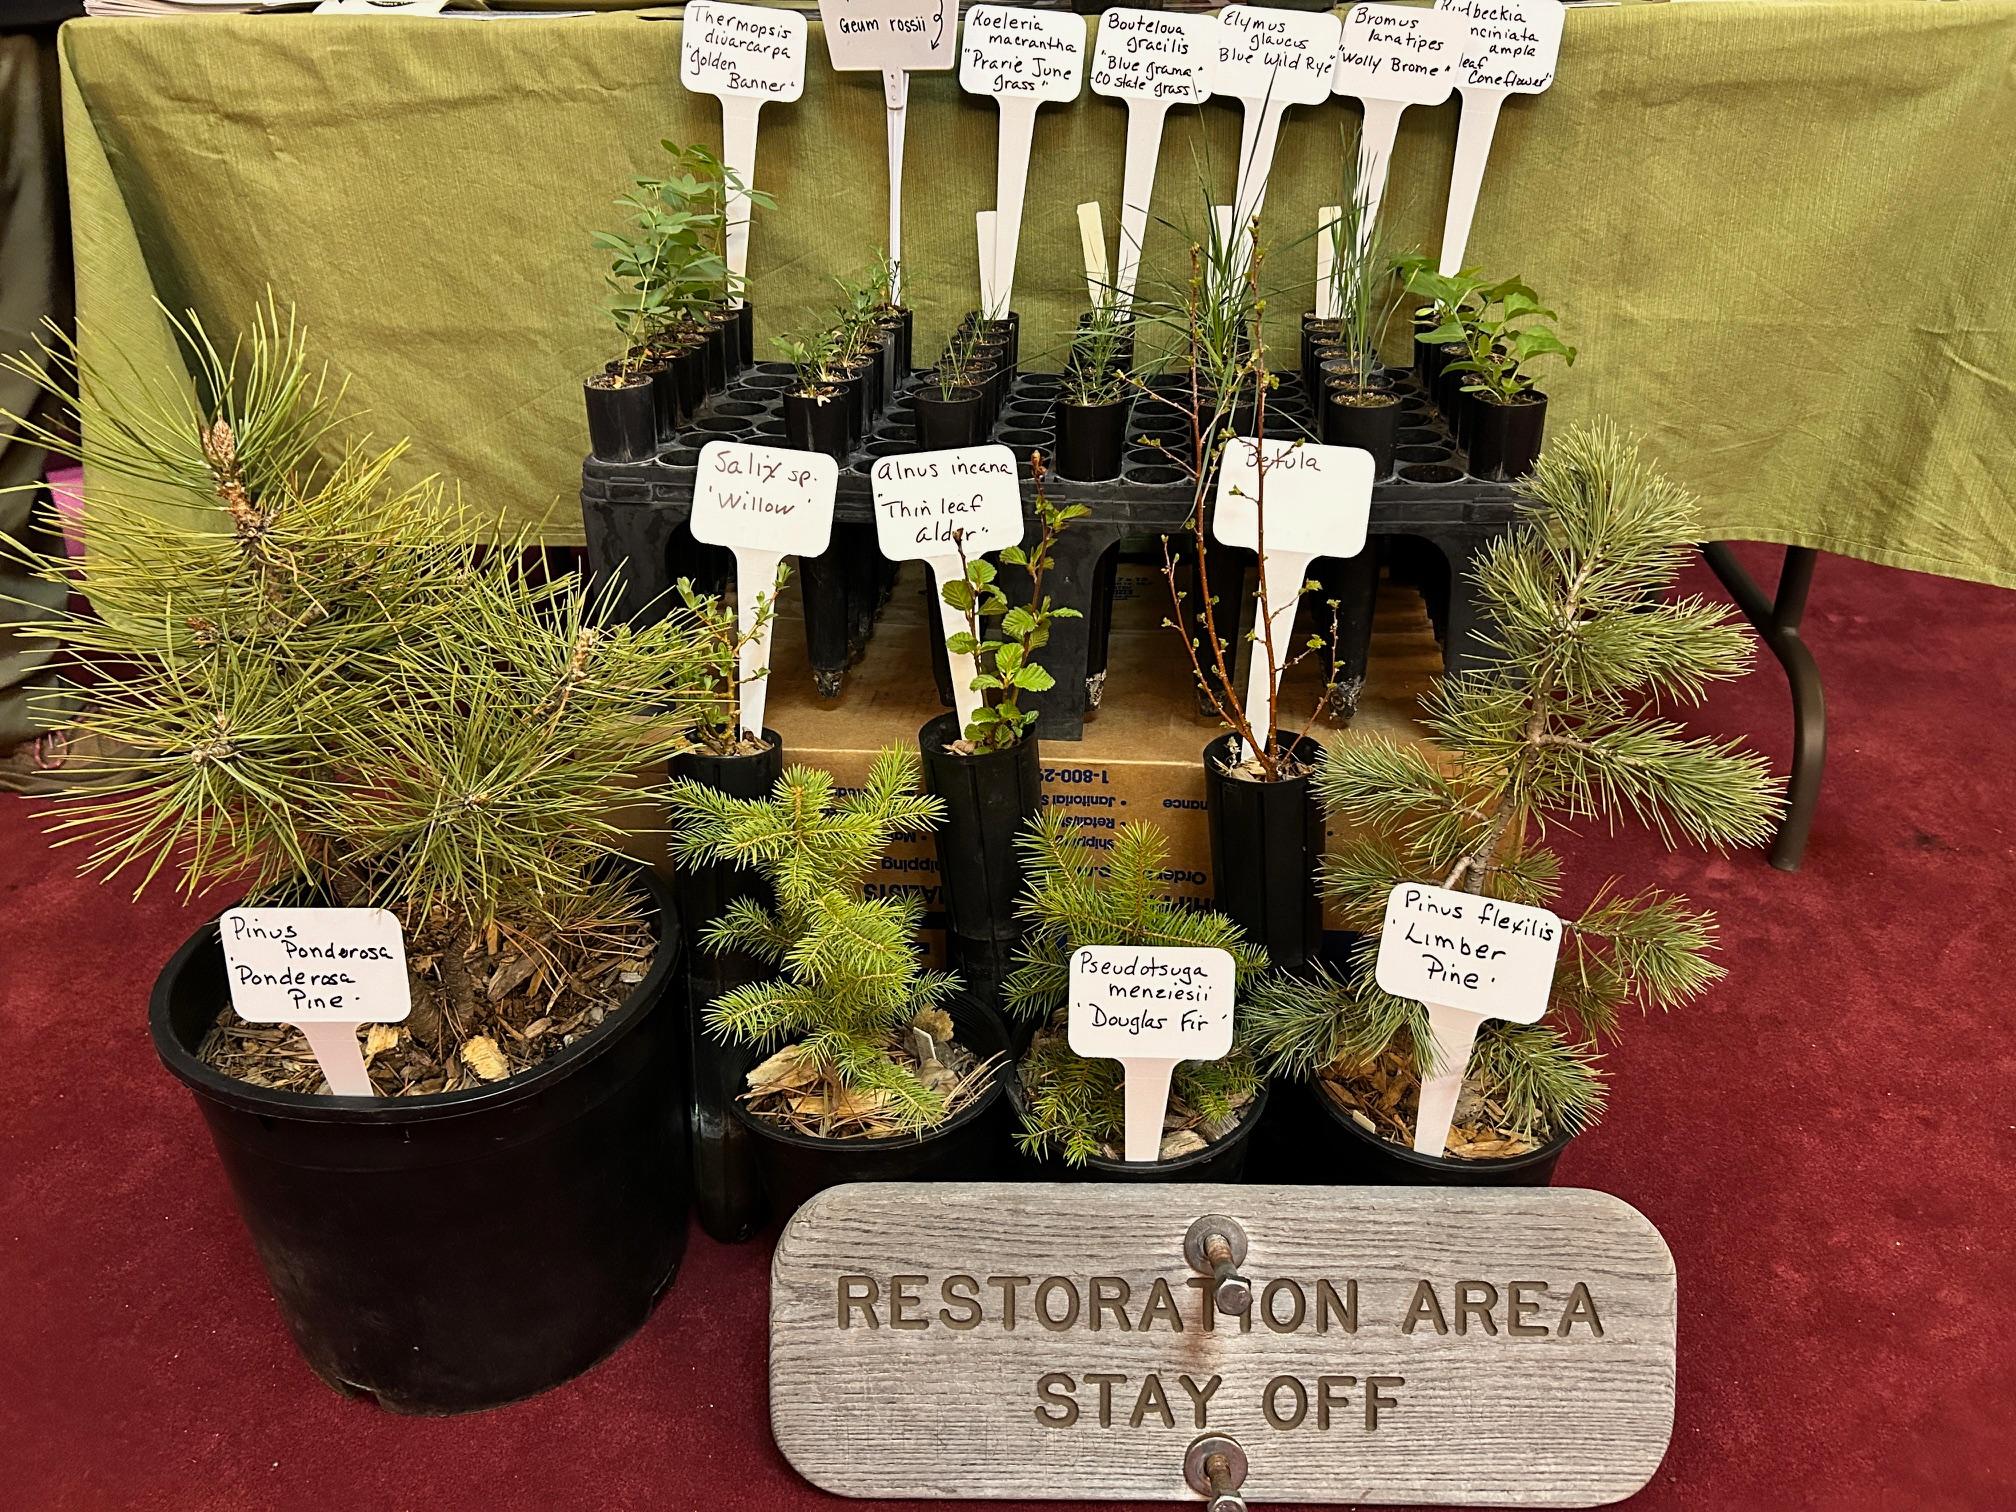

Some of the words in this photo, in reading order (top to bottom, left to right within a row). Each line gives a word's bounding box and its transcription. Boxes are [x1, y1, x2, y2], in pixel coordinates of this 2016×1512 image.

[690, 5, 793, 39] Thermopsis
[839, 17, 880, 34] Geum
[889, 16, 926, 33] rossii
[972, 9, 1044, 32] Koeleria
[1107, 12, 1186, 36] Bouteloua
[1224, 11, 1286, 33] Elymus
[1354, 7, 1419, 29] Bromus
[988, 34, 1077, 54] macrantha
[1126, 36, 1189, 55] gracilis
[1249, 33, 1309, 52] glaucus
[1367, 28, 1444, 51] lanatipes
[1264, 51, 1302, 70] Wild
[1489, 44, 1536, 58] ampla
[1032, 57, 1072, 81] June
[1114, 73, 1146, 90] state
[714, 450, 782, 484] Salix
[787, 470, 818, 488] sp.
[951, 456, 1013, 475] incana
[1242, 444, 1322, 472] Betula
[1053, 795, 1116, 807] Janitorial
[1162, 799, 1208, 810] nance
[1405, 890, 1462, 919] Pinus
[1478, 903, 1553, 941] flexilis
[230, 916, 297, 940] Pinus
[1080, 951, 1208, 985] Pseudotsuga
[1109, 981, 1212, 1002] menziesii
[1402, 1279, 1605, 1339] AREA
[1034, 1370, 1222, 1430] STAY
[1261, 1373, 1407, 1432] OFF
